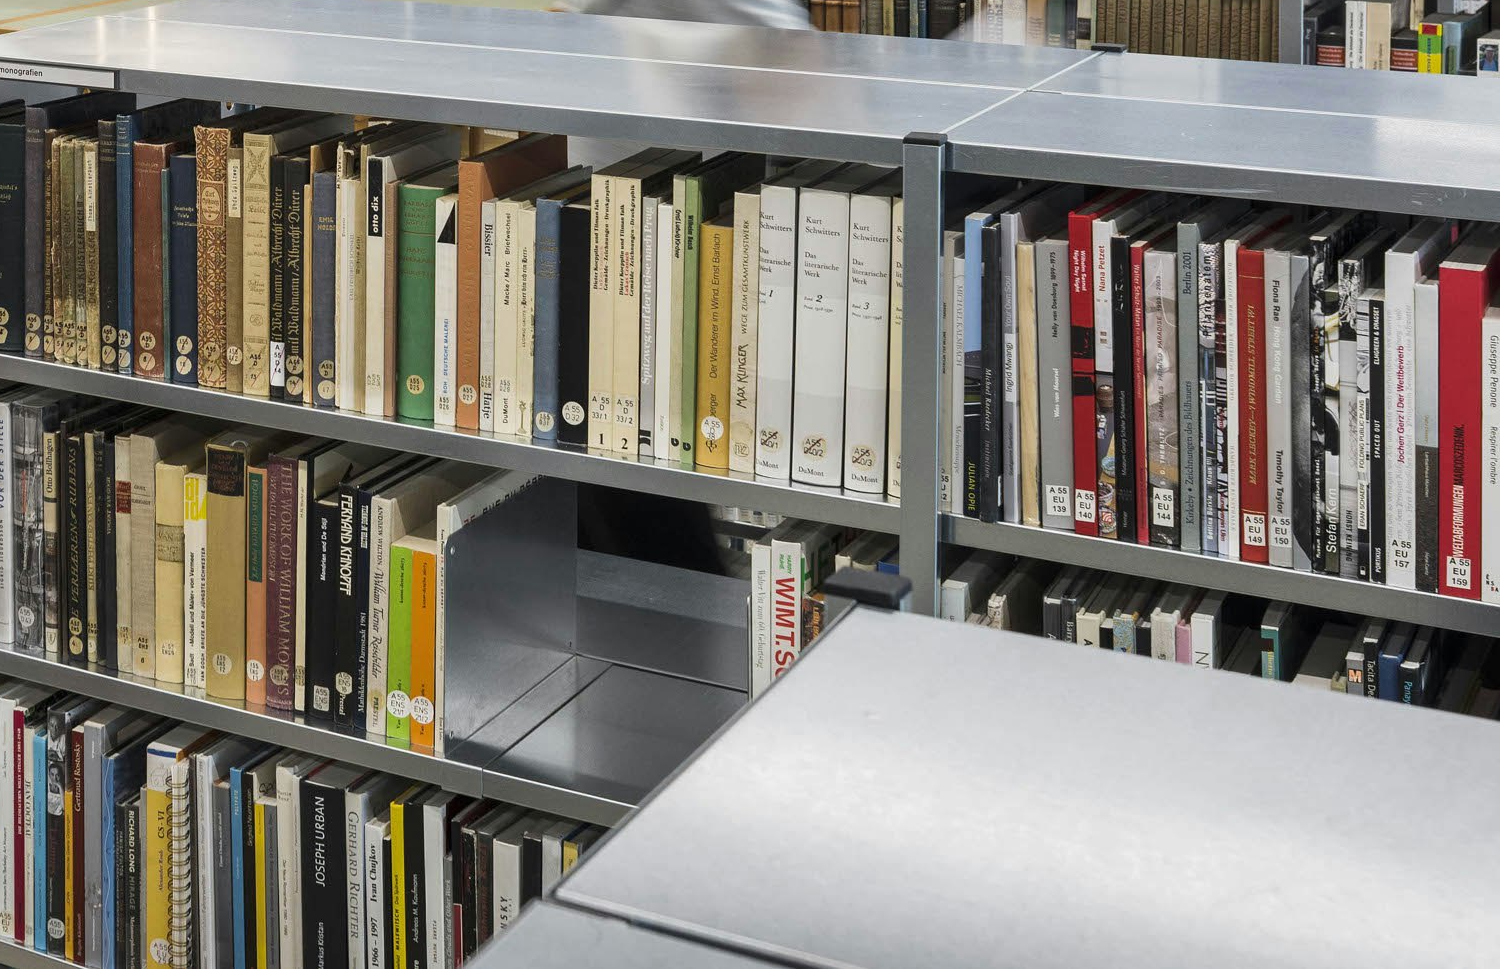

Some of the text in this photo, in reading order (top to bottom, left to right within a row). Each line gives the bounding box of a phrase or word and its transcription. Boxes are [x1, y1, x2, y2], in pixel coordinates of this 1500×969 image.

[371, 196, 379, 211] dix
[805, 226, 840, 237] Schwitters
[806, 216, 822, 225] Kurt
[853, 223, 870, 232] Kurt
[484, 224, 493, 256] Bissier
[852, 233, 889, 243] Schwitters
[741, 220, 750, 293] GESAMTKUNSTWERK
[804, 261, 840, 272] literarische
[852, 258, 864, 266] Das
[1098, 246, 1106, 268] Petzet
[804, 269, 820, 279] Werk
[852, 267, 888, 278] literarische
[852, 276, 867, 286] Werk
[709, 233, 721, 378] Der Wanderer im Wind. Ernst Barlach
[815, 294, 823, 303] 2
[736, 344, 748, 383] KLINGER
[1004, 342, 1014, 393] Ingrid Mwangi
[1490, 335, 1498, 408] Giuseppe Penone
[482, 392, 492, 419] Hatje
[736, 386, 748, 409] MAX
[1184, 380, 1192, 420] Bildhauers
[1396, 345, 1406, 463] Jochen Gerz Der Wettbewerb
[45, 438, 54, 476] Bollhagen
[622, 438, 628, 449] 2
[798, 466, 824, 477] DuMont
[1185, 436, 1194, 485] Zeichnungen
[851, 473, 878, 483] DuMont
[968, 461, 976, 511] JULIAN OPIE
[1275, 449, 1284, 513] Timothy Taylor
[1185, 494, 1195, 524] Kirkeby
[1326, 488, 1337, 553] Stefan Kern
[279, 464, 292, 633] THE WORK OF WILLIAM
[340, 494, 353, 596] FERNAND KHNOPFF
[1248, 536, 1263, 544] 149
[1274, 536, 1289, 545] 150
[1393, 559, 1409, 568] 157
[1451, 578, 1468, 587] 159
[74, 742, 83, 812] Gertraud Rostosky
[128, 810, 136, 846] RICHARD
[315, 796, 326, 887] JOSEPH URBAN
[128, 847, 136, 873] LONG
[369, 842, 378, 902] Ivan Chujkov
[348, 811, 360, 939] GERHARD RICHTER
